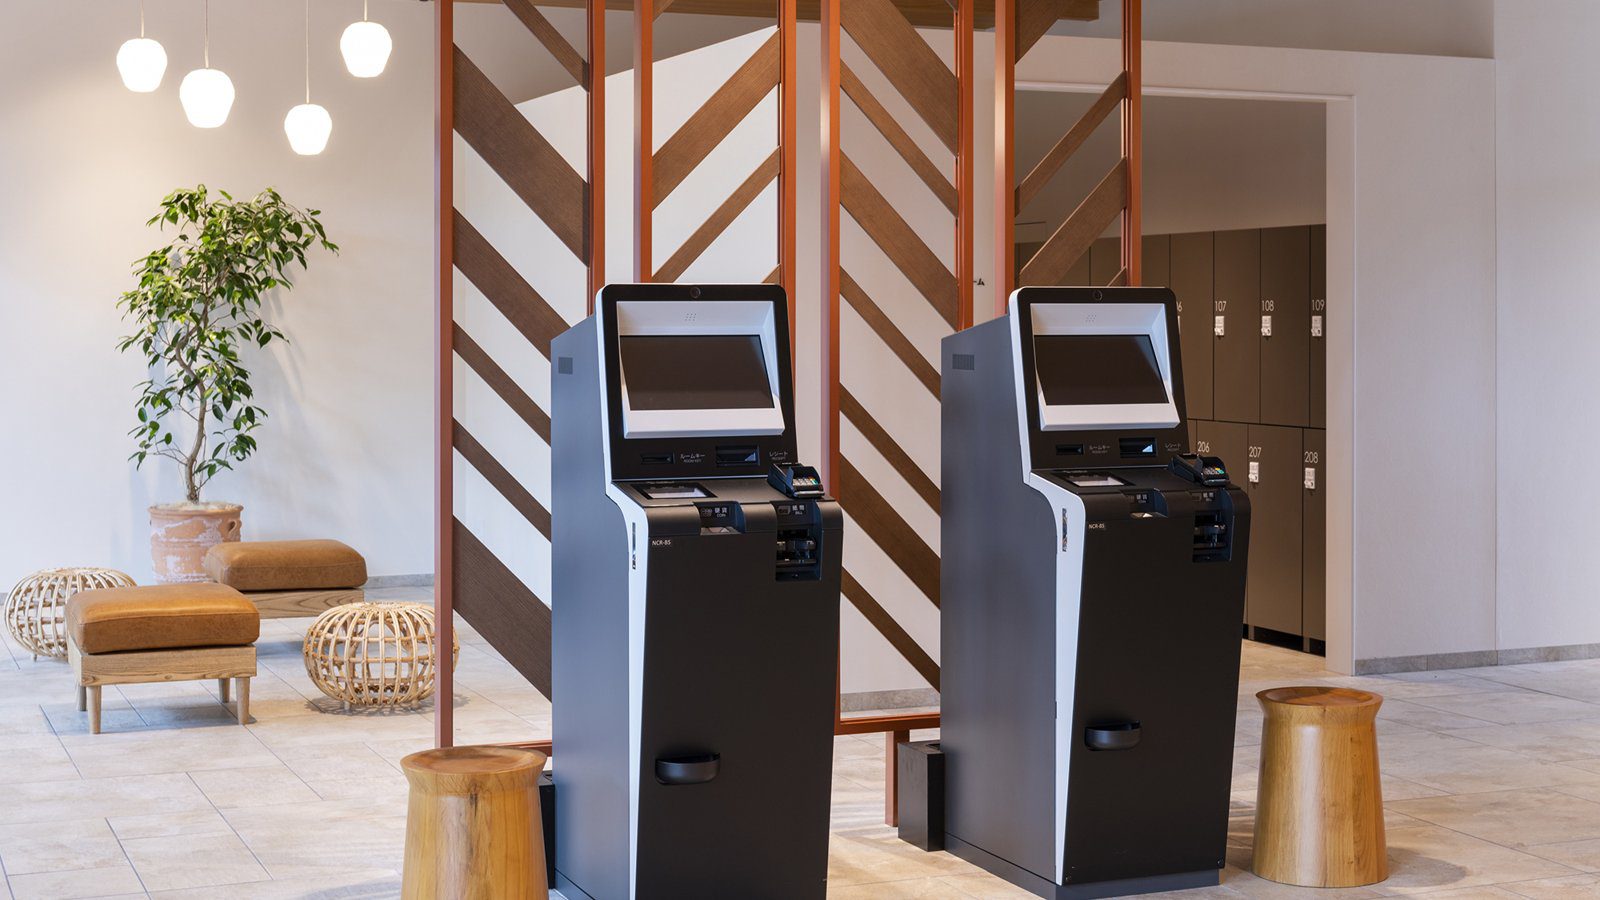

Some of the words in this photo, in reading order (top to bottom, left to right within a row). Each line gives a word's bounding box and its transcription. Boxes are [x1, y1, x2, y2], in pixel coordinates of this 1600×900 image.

[1214, 300, 1227, 312] 107
[1261, 300, 1275, 312] 108
[1312, 299, 1325, 312] 109
[1197, 441, 1210, 453] 206
[1248, 446, 1262, 458] 207
[1304, 451, 1319, 464] 208
